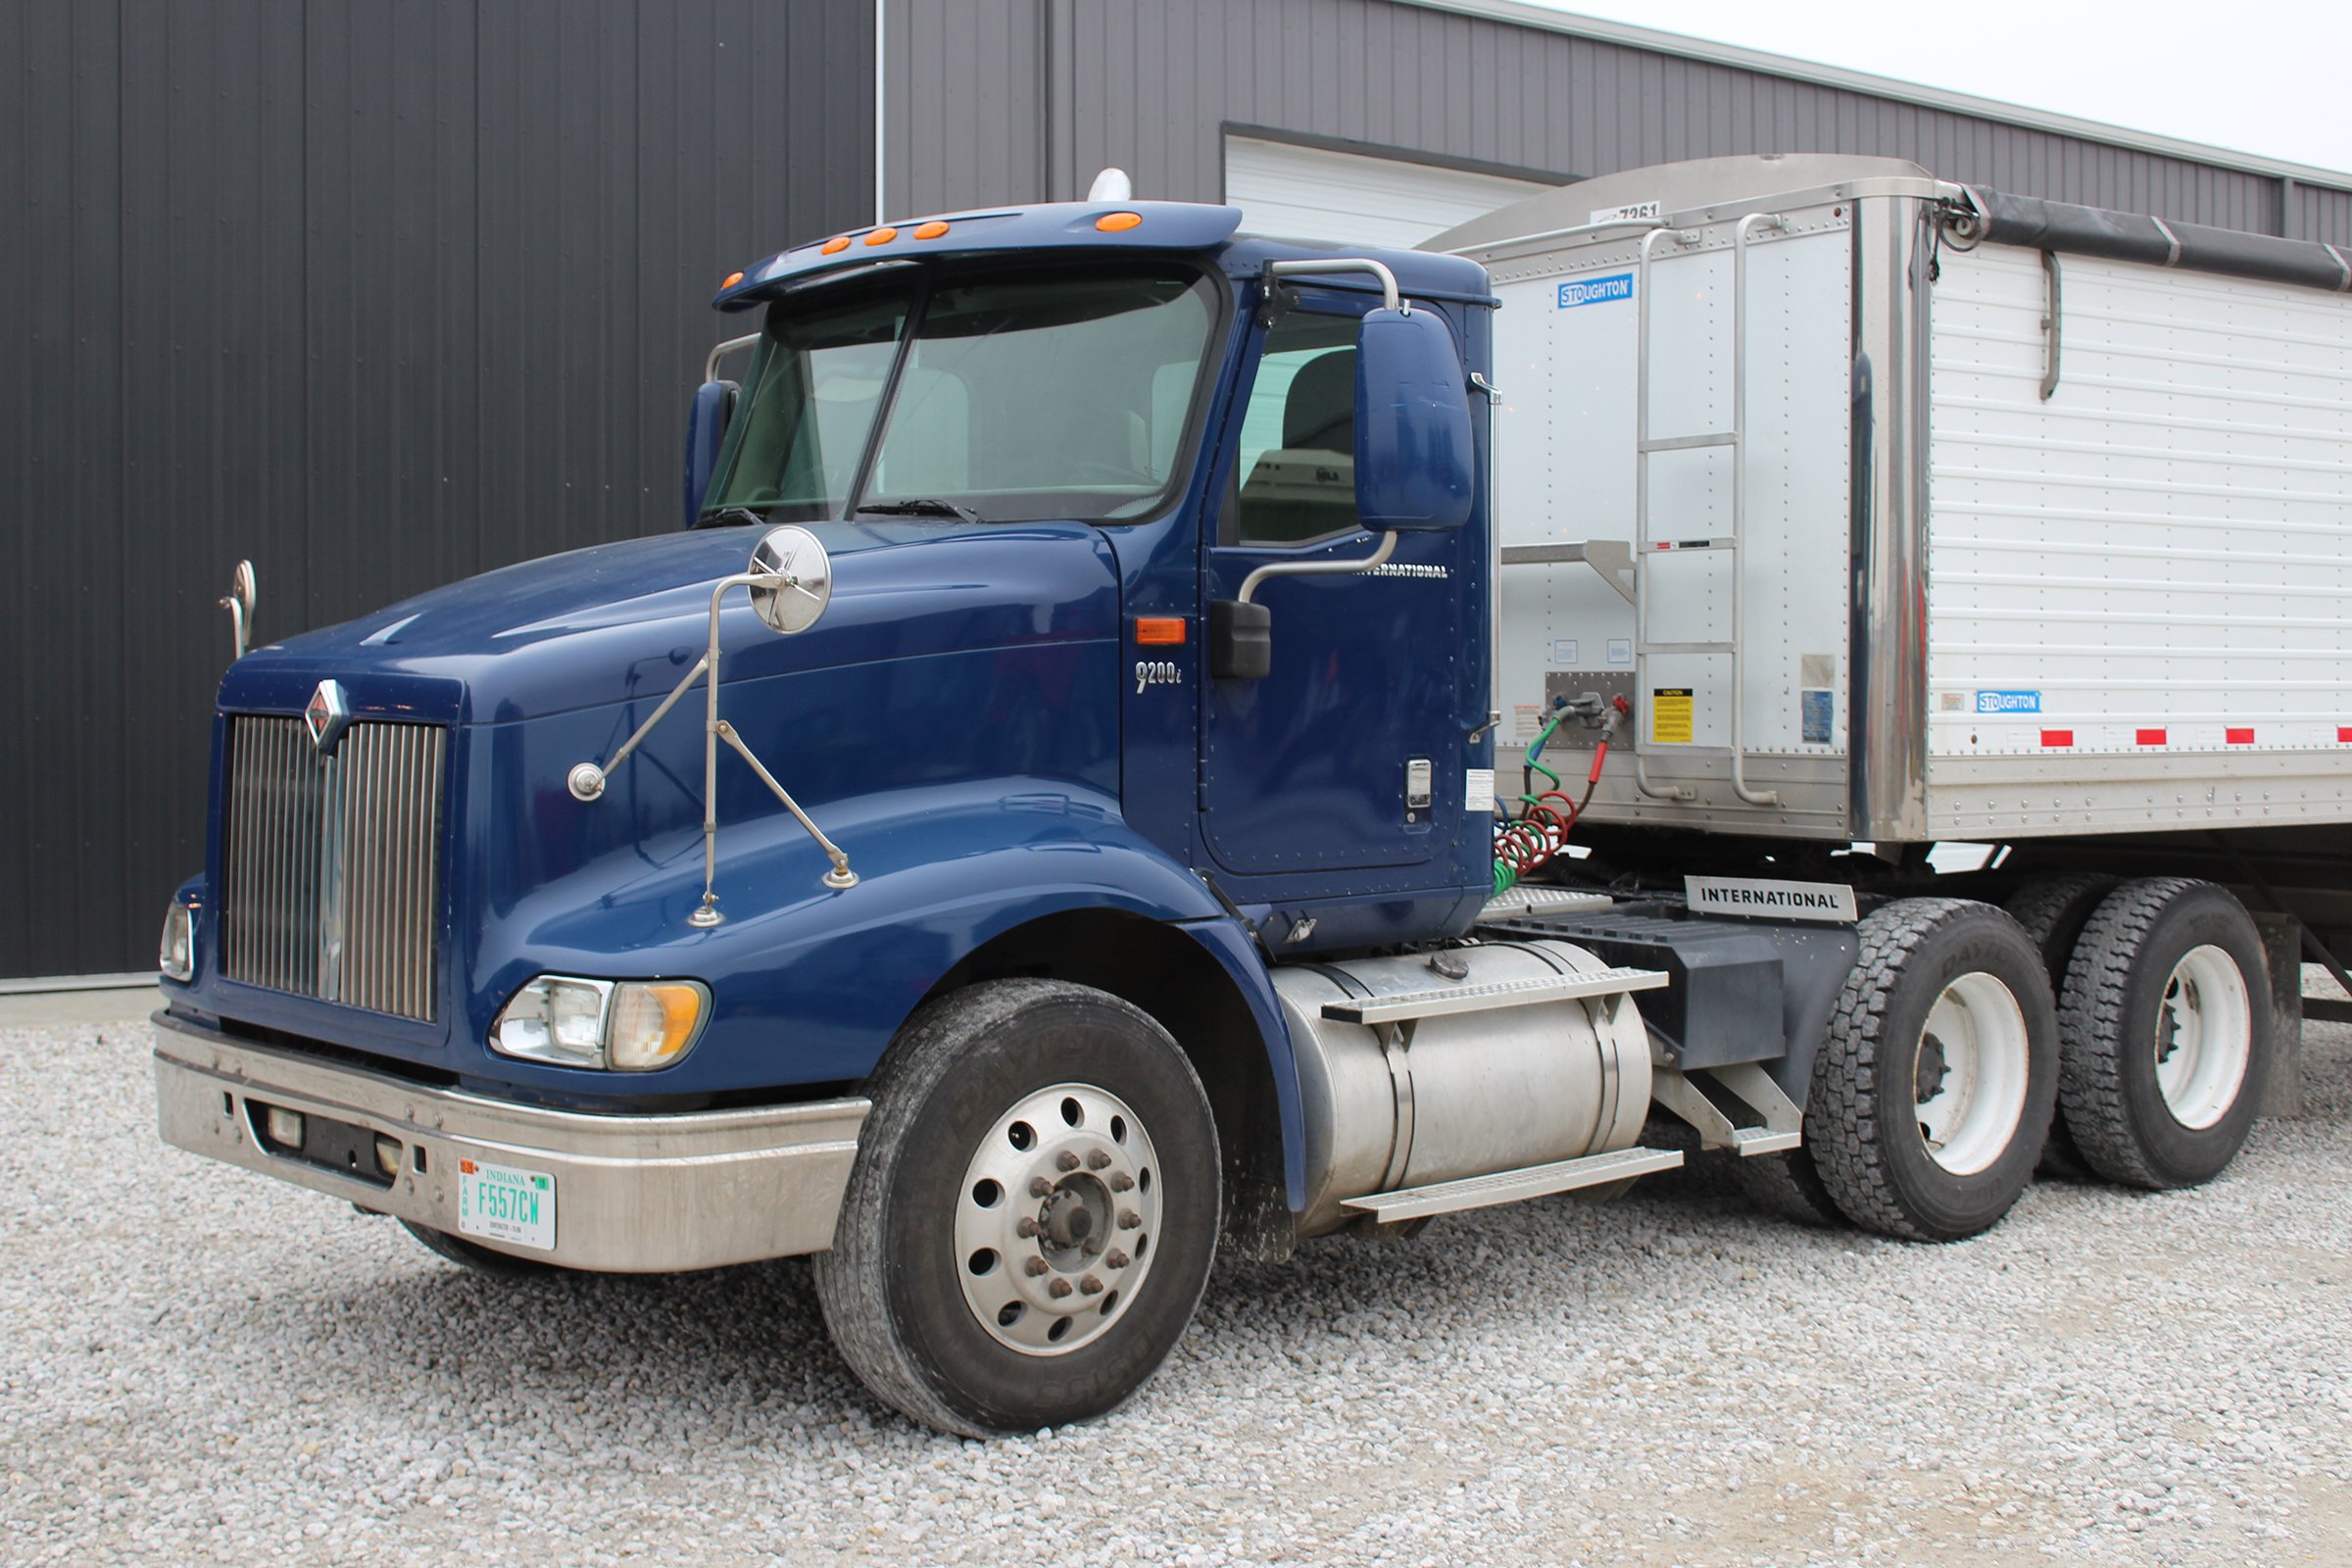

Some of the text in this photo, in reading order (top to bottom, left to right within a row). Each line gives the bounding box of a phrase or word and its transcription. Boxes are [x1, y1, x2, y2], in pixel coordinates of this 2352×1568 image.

[1560, 279, 1629, 303] STOUGHTON
[1353, 564, 1448, 578] ERNATIONAL
[1136, 662, 1182, 694] 9200i
[1980, 694, 2036, 710] STOUGHTON
[1701, 887, 1838, 908] INTERNATIONAL
[486, 1169, 525, 1187] INDIANA
[478, 1182, 538, 1226] F557CW
